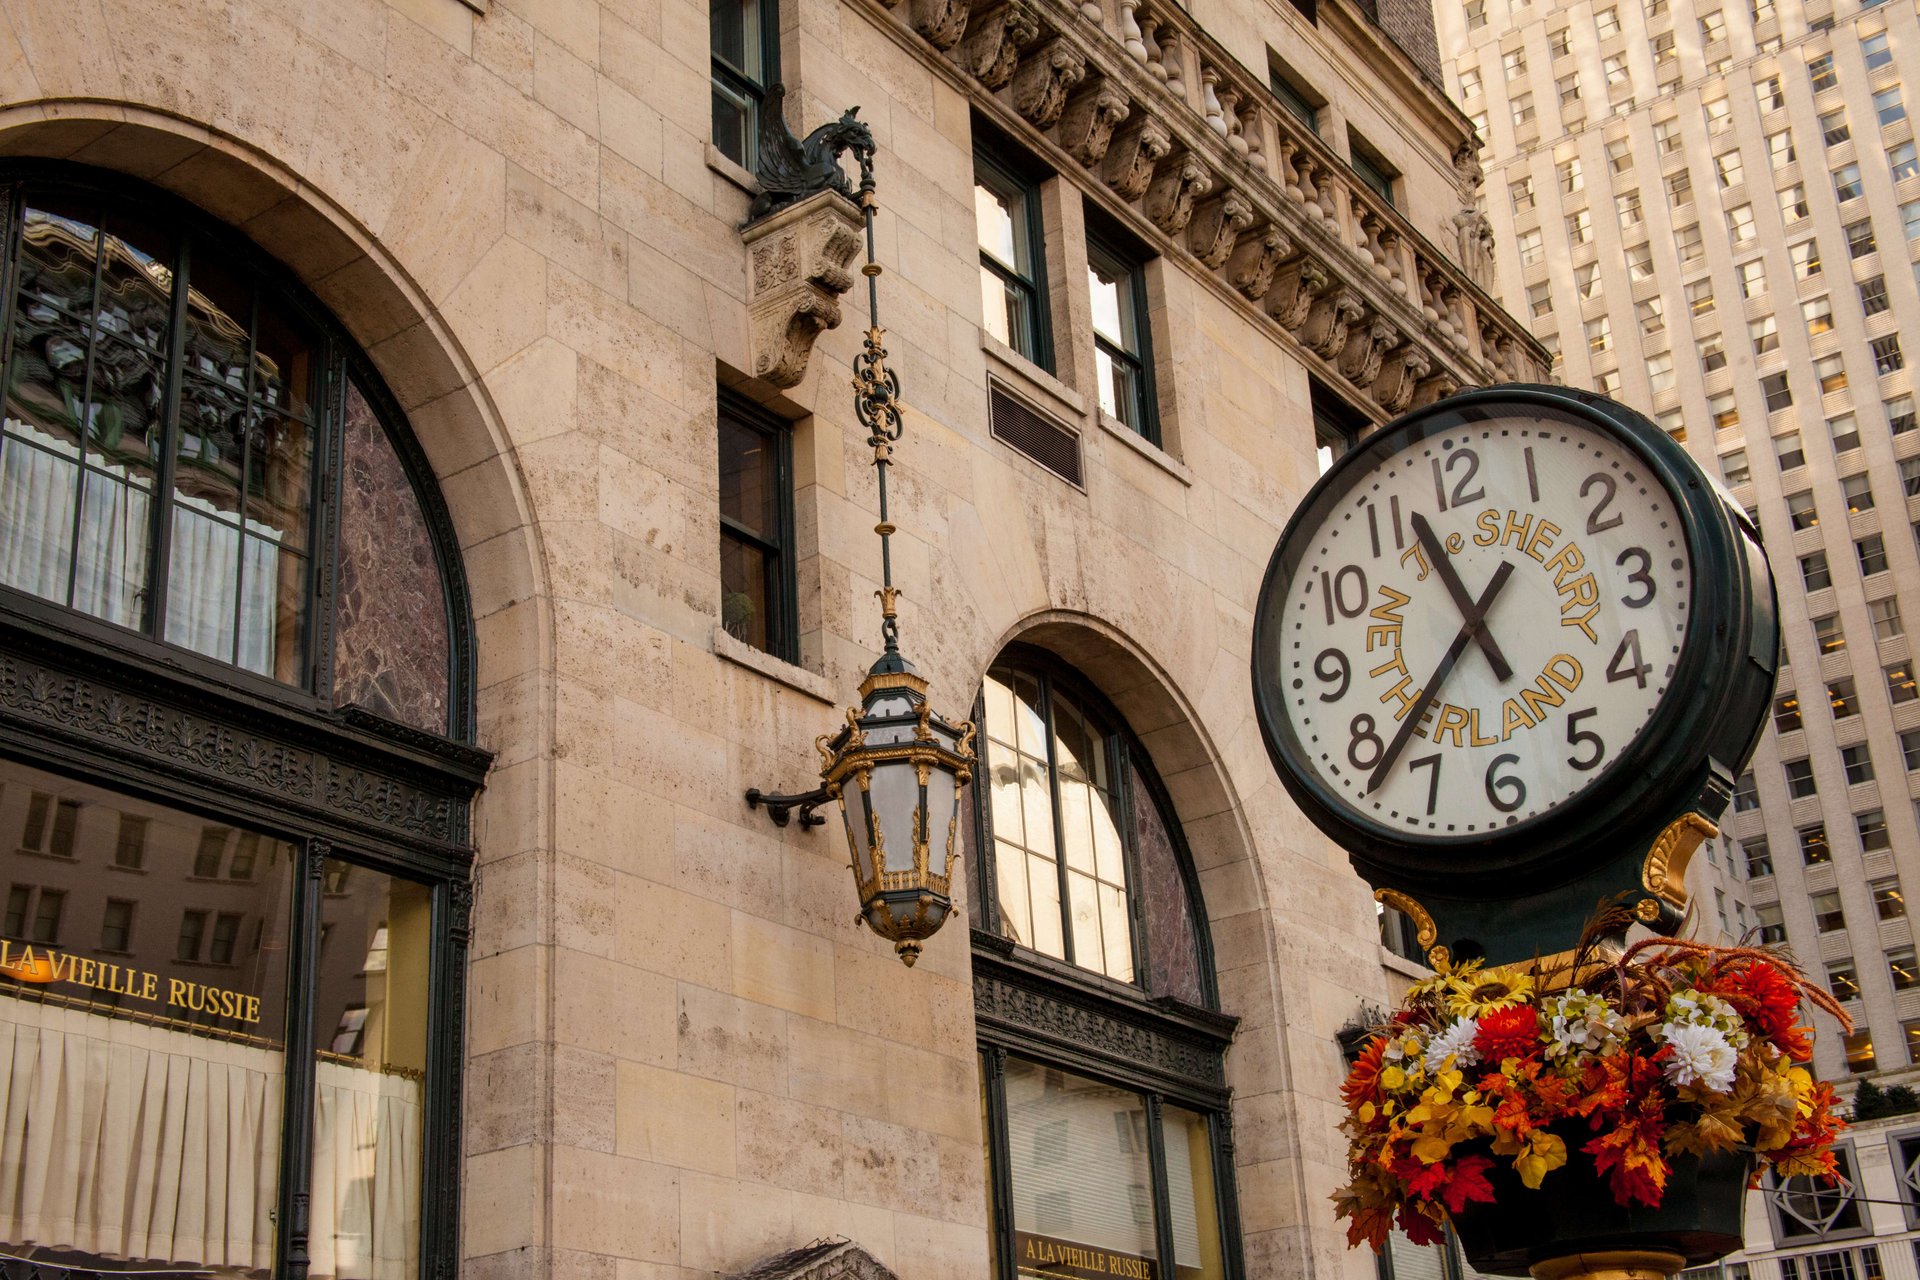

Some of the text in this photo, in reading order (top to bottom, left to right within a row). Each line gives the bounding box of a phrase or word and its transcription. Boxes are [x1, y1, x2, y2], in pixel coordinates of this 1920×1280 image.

[1432, 448, 1485, 512] 12
[1524, 447, 1540, 502] 1
[1580, 472, 1624, 535] 2
[1367, 495, 1404, 558] 11
[1321, 564, 1369, 625] 10
[1400, 509, 1601, 645] Te SHERRY
[1615, 547, 1657, 609] 3
[1313, 648, 1351, 702] 9
[1605, 629, 1653, 689] 4
[1347, 713, 1385, 771] 8
[1566, 707, 1605, 771] 5
[1409, 753, 1442, 815] 7
[1485, 754, 1527, 812] 6
[0, 939, 261, 1024] LA VIEILLE RUSSIE
[1026, 1239, 1151, 1280] A LA VIEILLE RUSSIE
